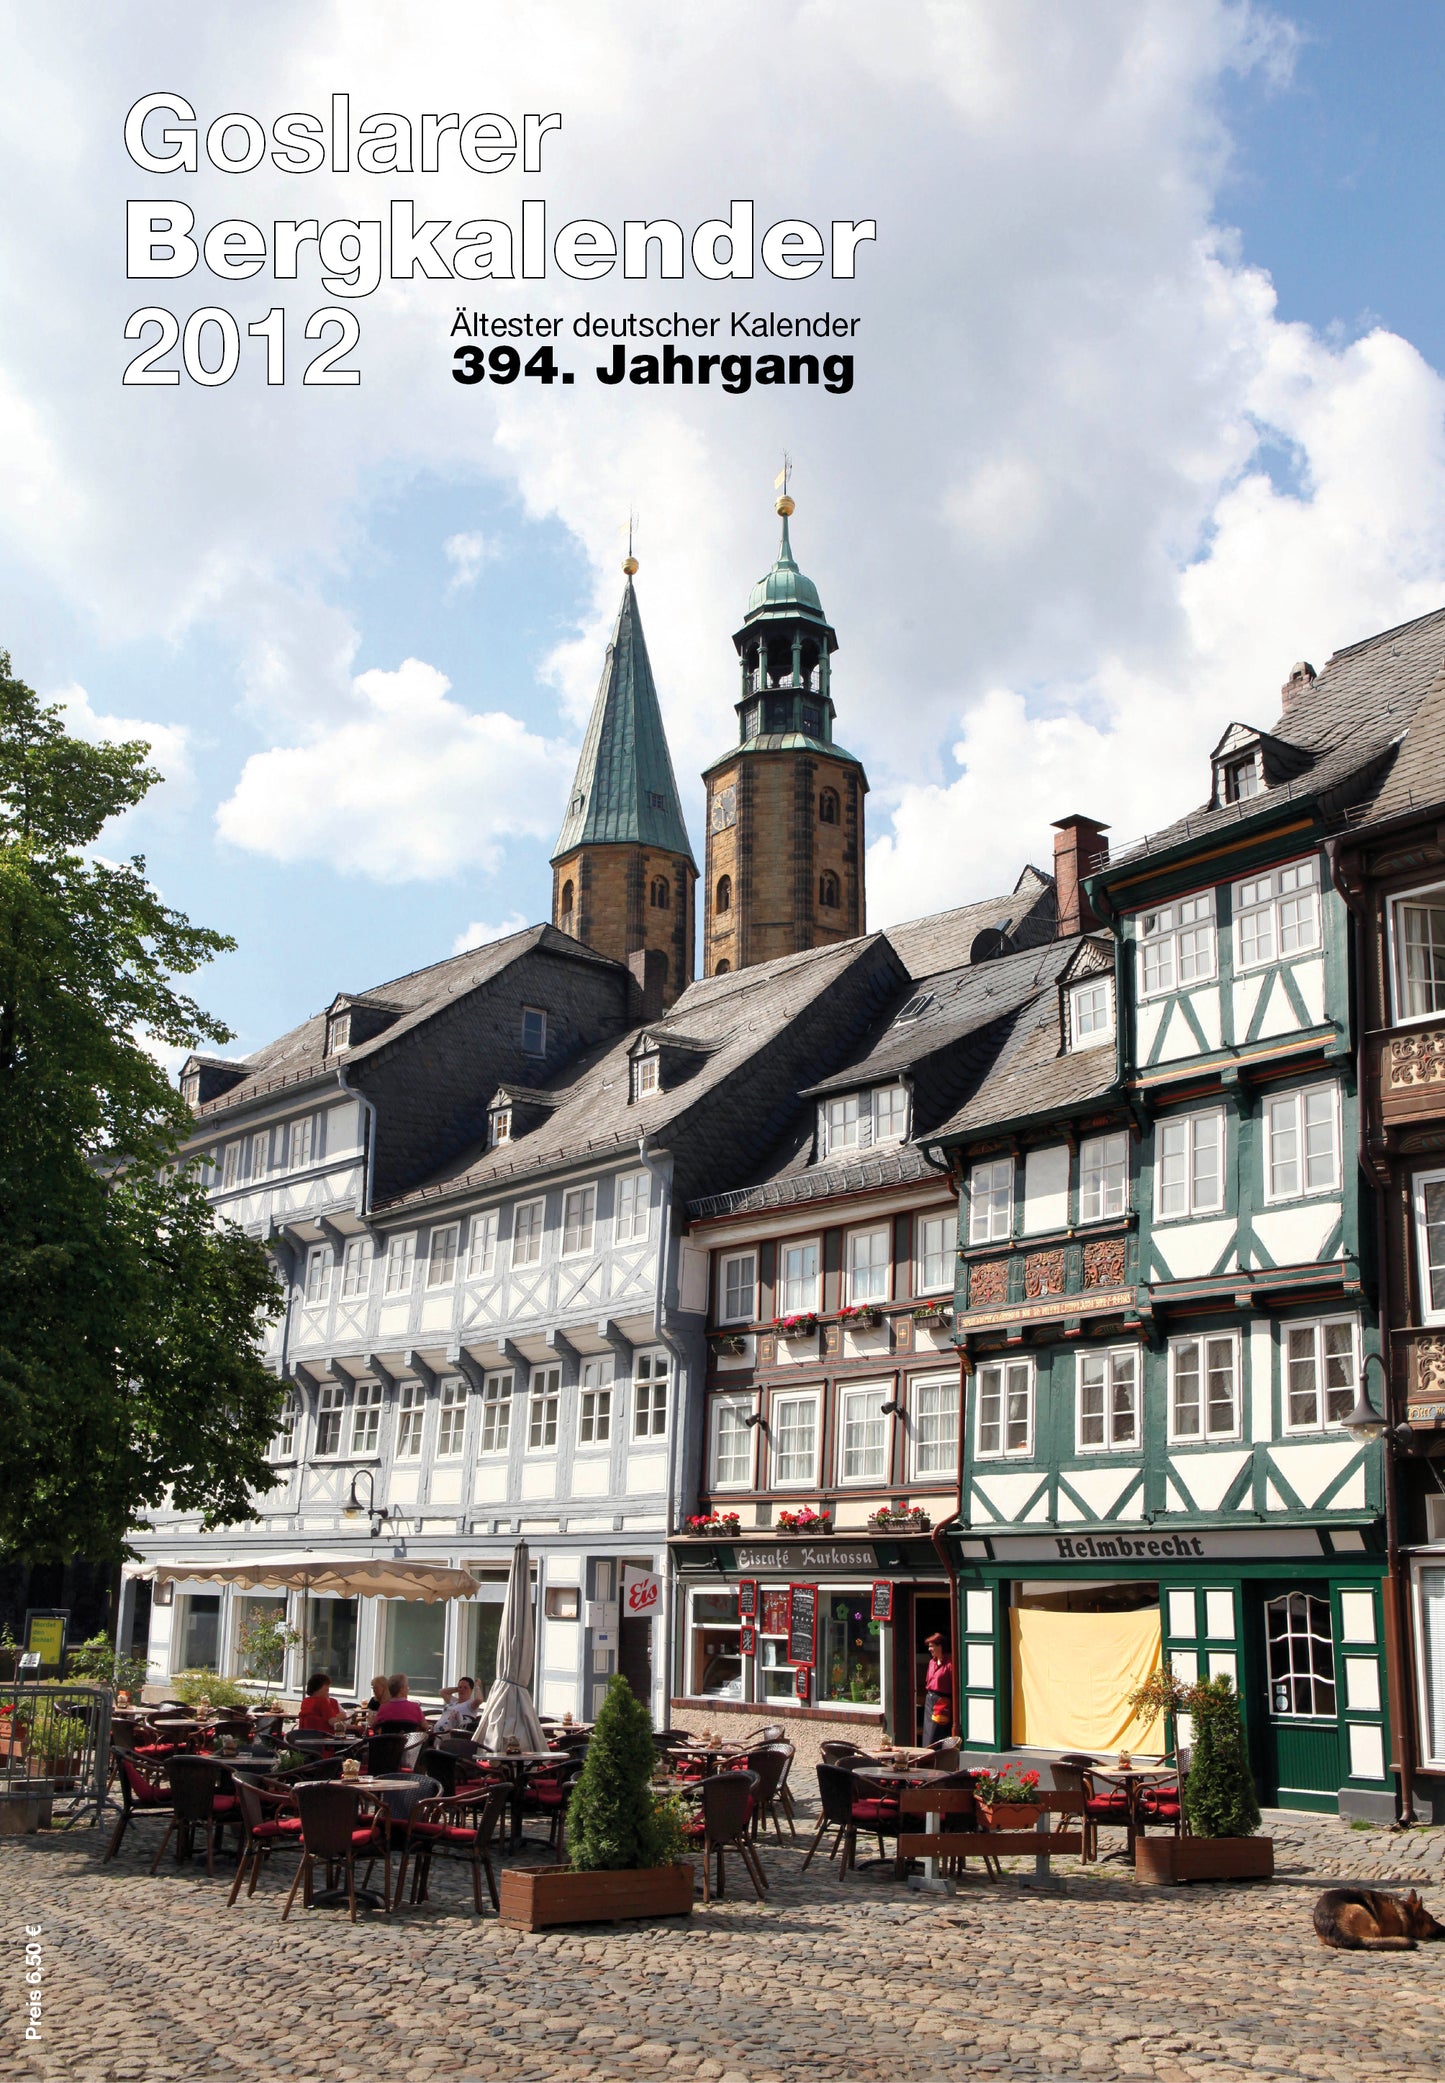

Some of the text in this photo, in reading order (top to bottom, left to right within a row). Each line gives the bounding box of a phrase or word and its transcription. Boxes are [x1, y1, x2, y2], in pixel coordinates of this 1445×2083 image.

[1055, 1535, 1204, 1558] Helmbrecht
[739, 1547, 872, 1570] Eiscafé Karkossa
[628, 1577, 658, 1609] Eis
